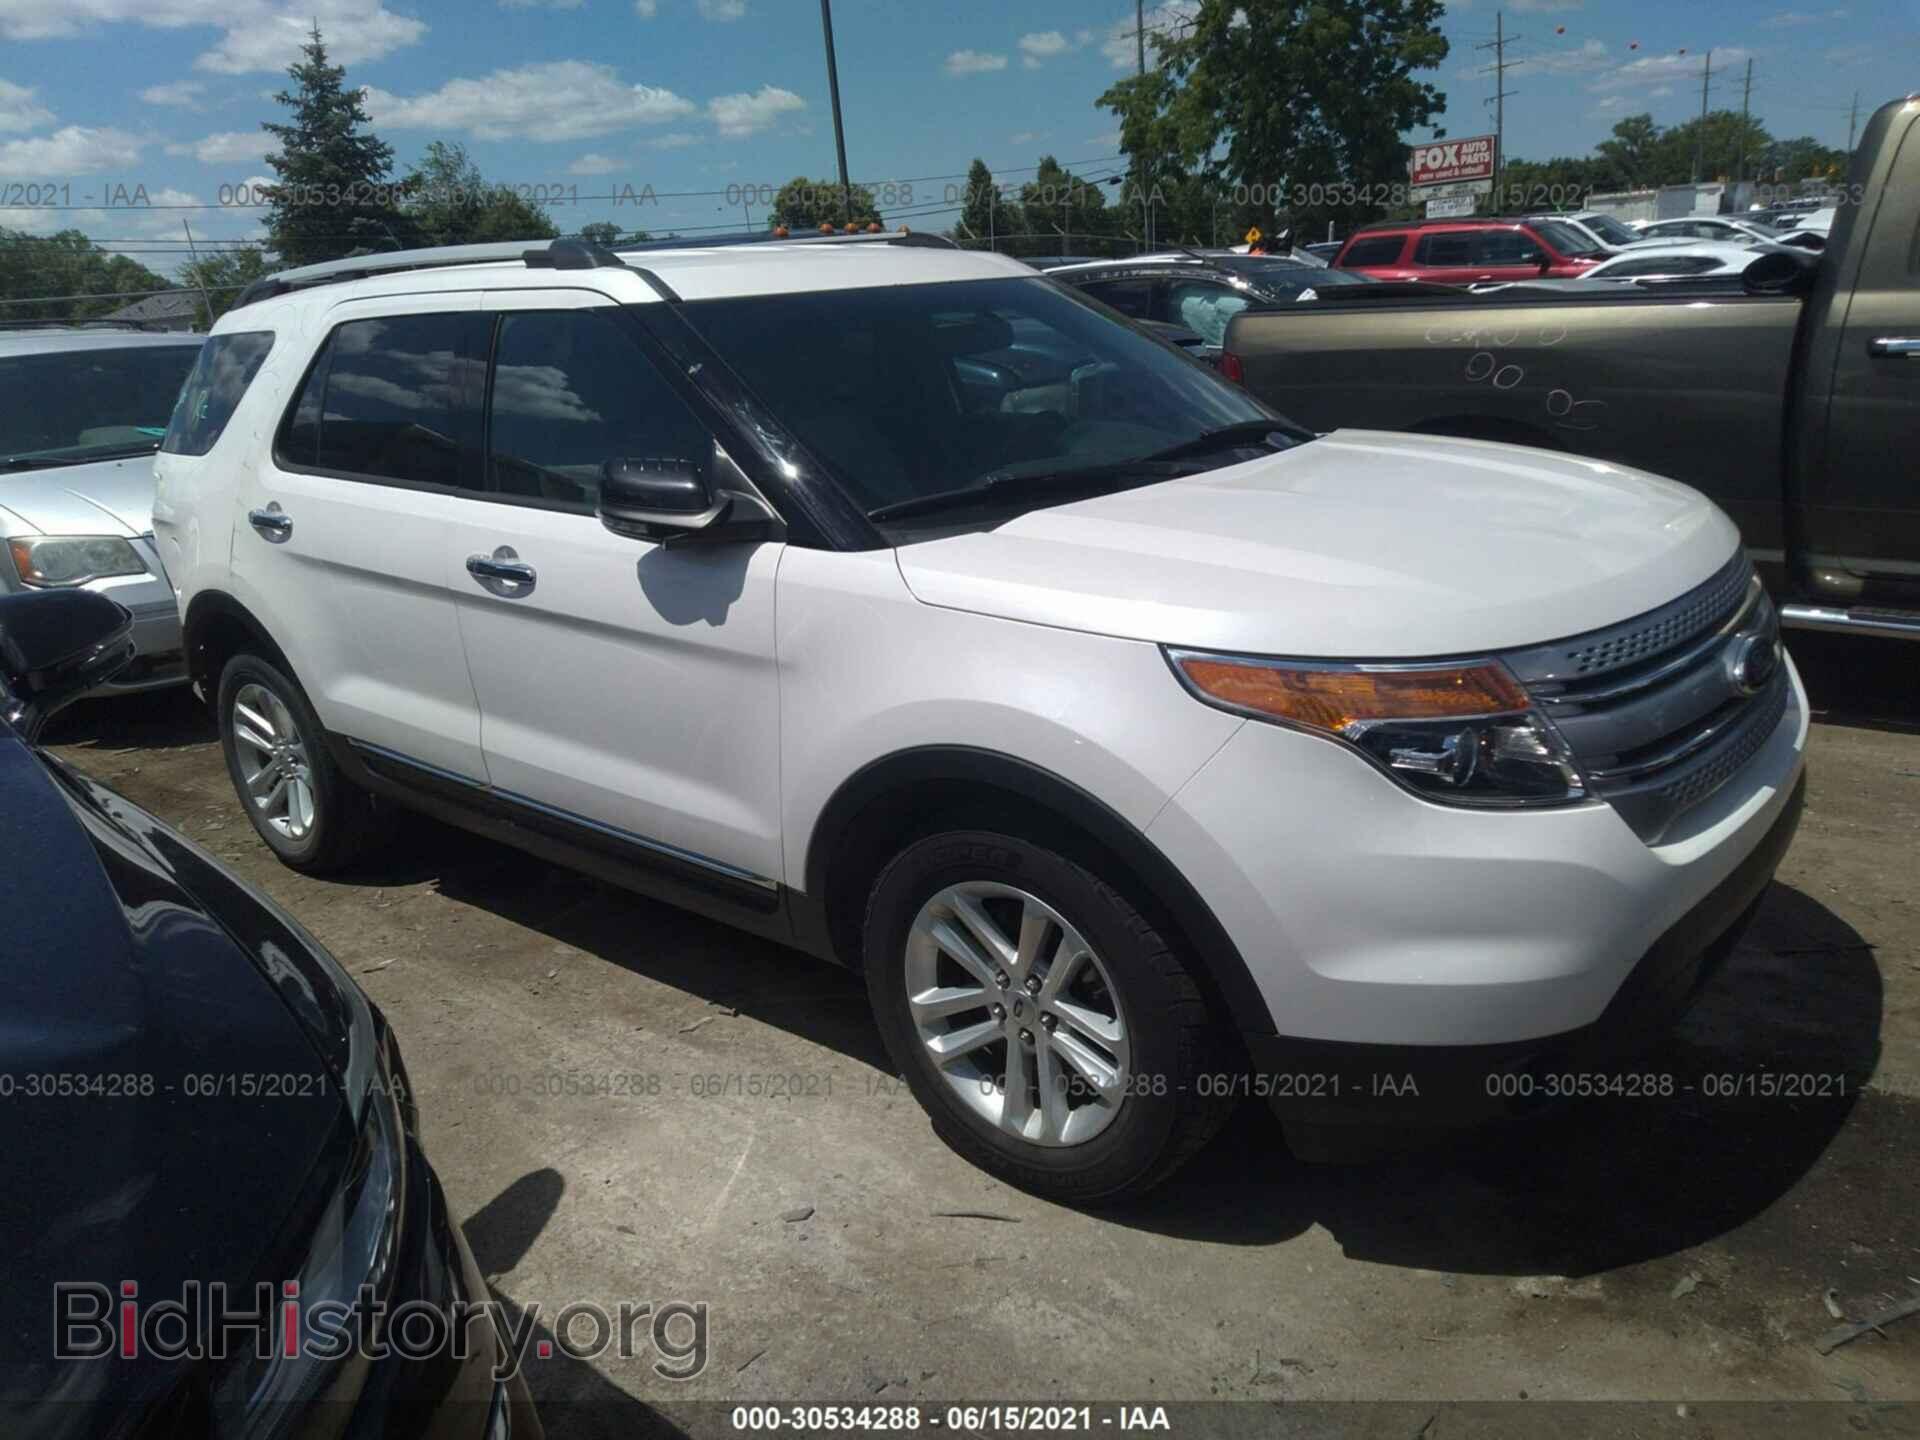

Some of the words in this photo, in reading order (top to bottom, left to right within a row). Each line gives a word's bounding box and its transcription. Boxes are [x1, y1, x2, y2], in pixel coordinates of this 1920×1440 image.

[1414, 144, 1460, 171] FOX
[1461, 141, 1488, 153] AUTO
[1460, 152, 1491, 166] PARTS
